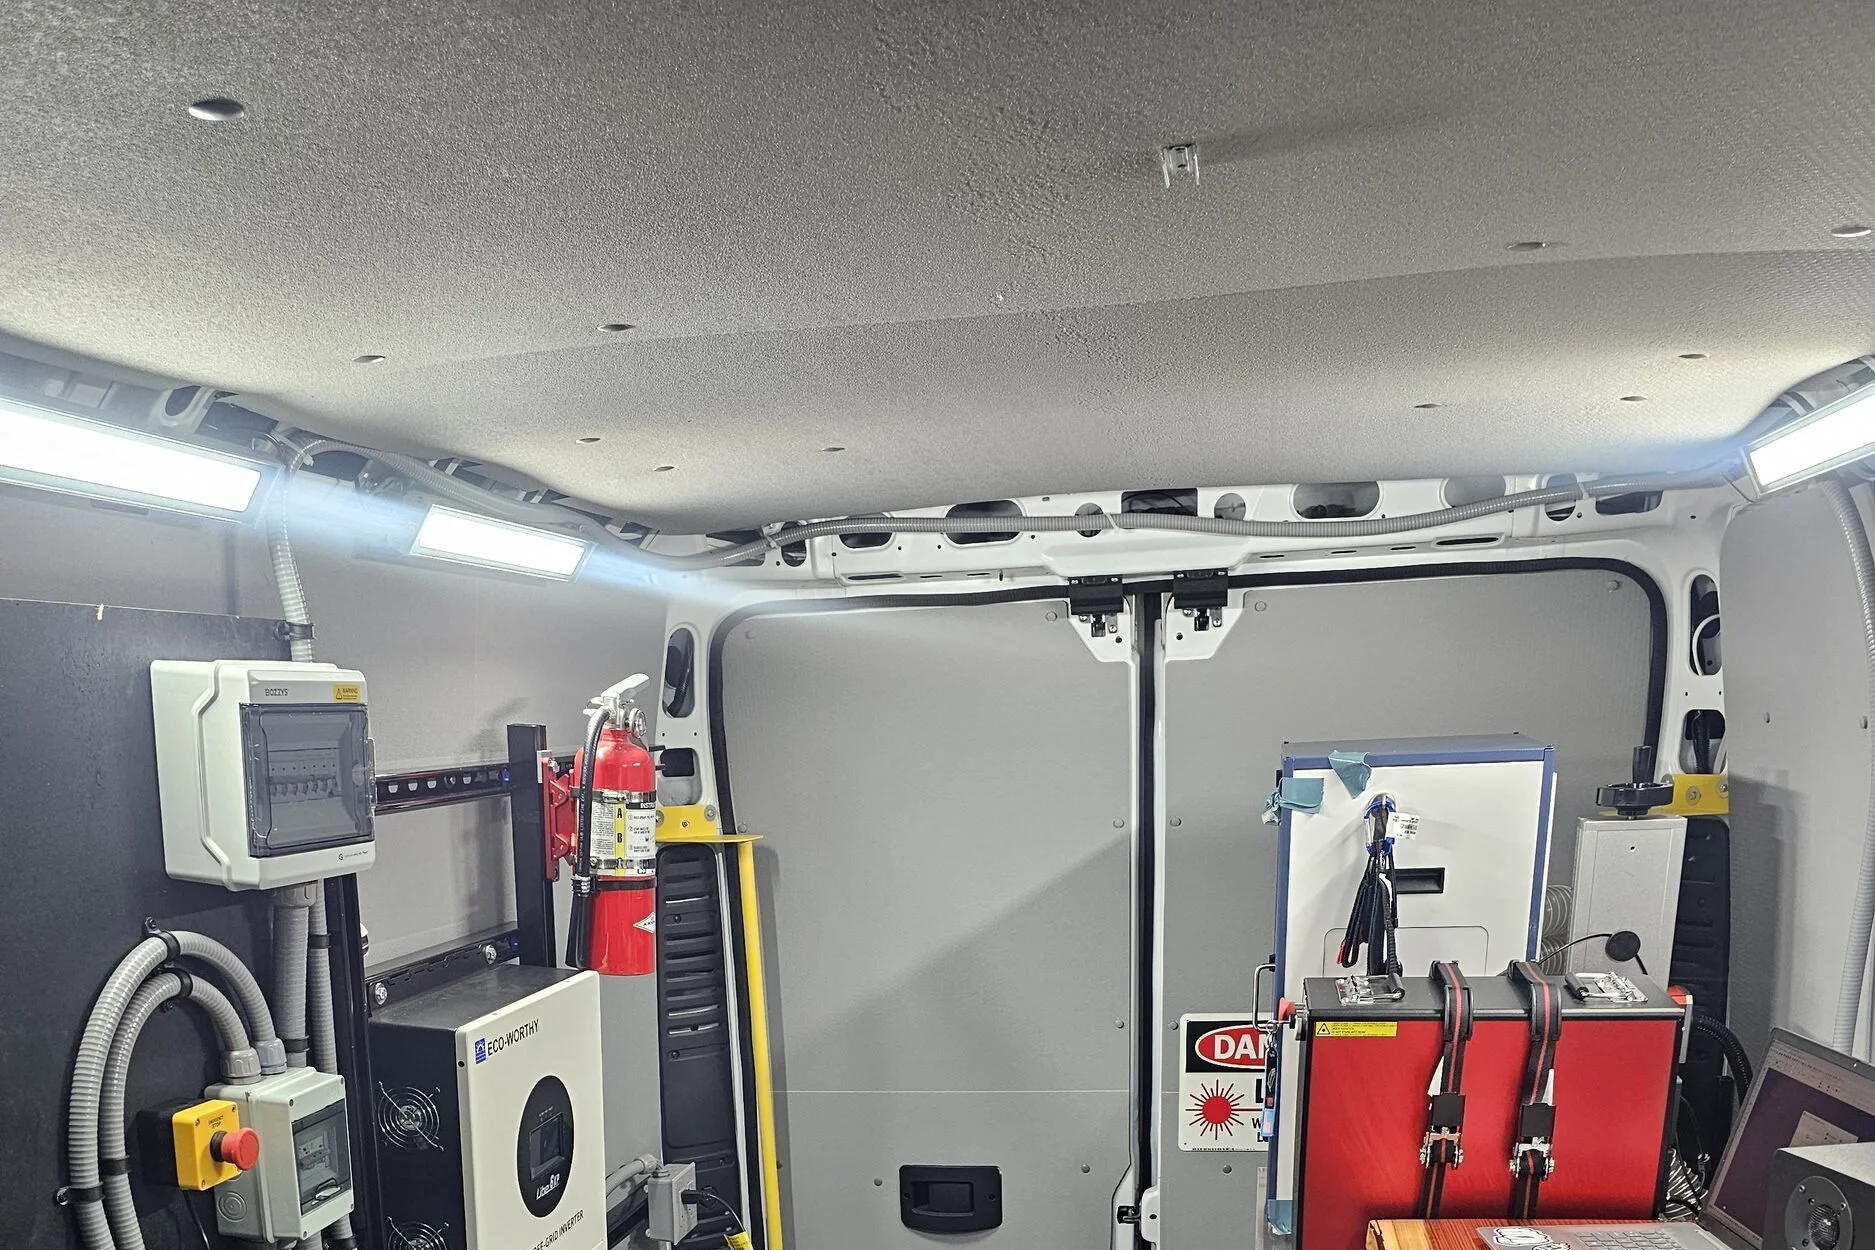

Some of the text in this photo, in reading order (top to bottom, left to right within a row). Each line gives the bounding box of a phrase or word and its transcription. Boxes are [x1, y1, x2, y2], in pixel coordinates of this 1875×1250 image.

[616, 807, 623, 819] A
[616, 832, 623, 844] B
[487, 1018, 539, 1056] ECO-WORTHY
[559, 1209, 584, 1237] INVERTER
